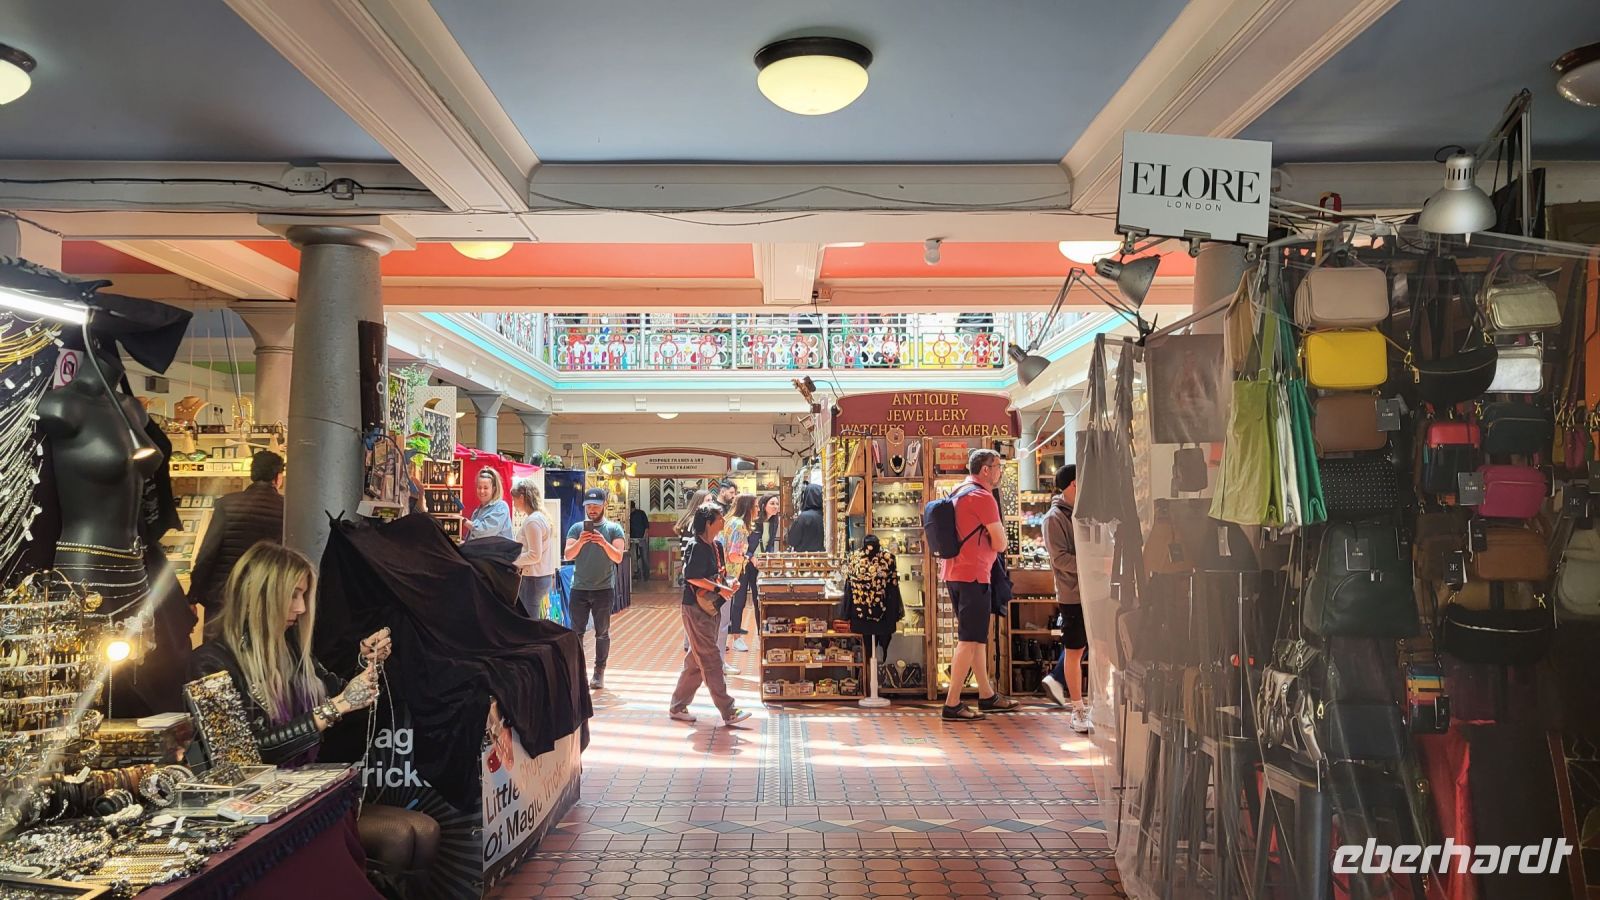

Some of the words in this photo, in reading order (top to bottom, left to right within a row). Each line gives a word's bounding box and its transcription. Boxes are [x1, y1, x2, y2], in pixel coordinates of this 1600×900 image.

[1128, 162, 1261, 204] ELORE
[1167, 201, 1222, 212] LONDON
[892, 394, 959, 406] ANTIQUE
[886, 409, 969, 421] JEWELLERY
[841, 424, 905, 436] WATCH
[918, 425, 928, 436] &
[942, 424, 1009, 436] CAMERAS
[353, 760, 432, 787] rick
[485, 778, 520, 825] Little
[484, 825, 503, 862] Of
[506, 794, 543, 845] Magic
